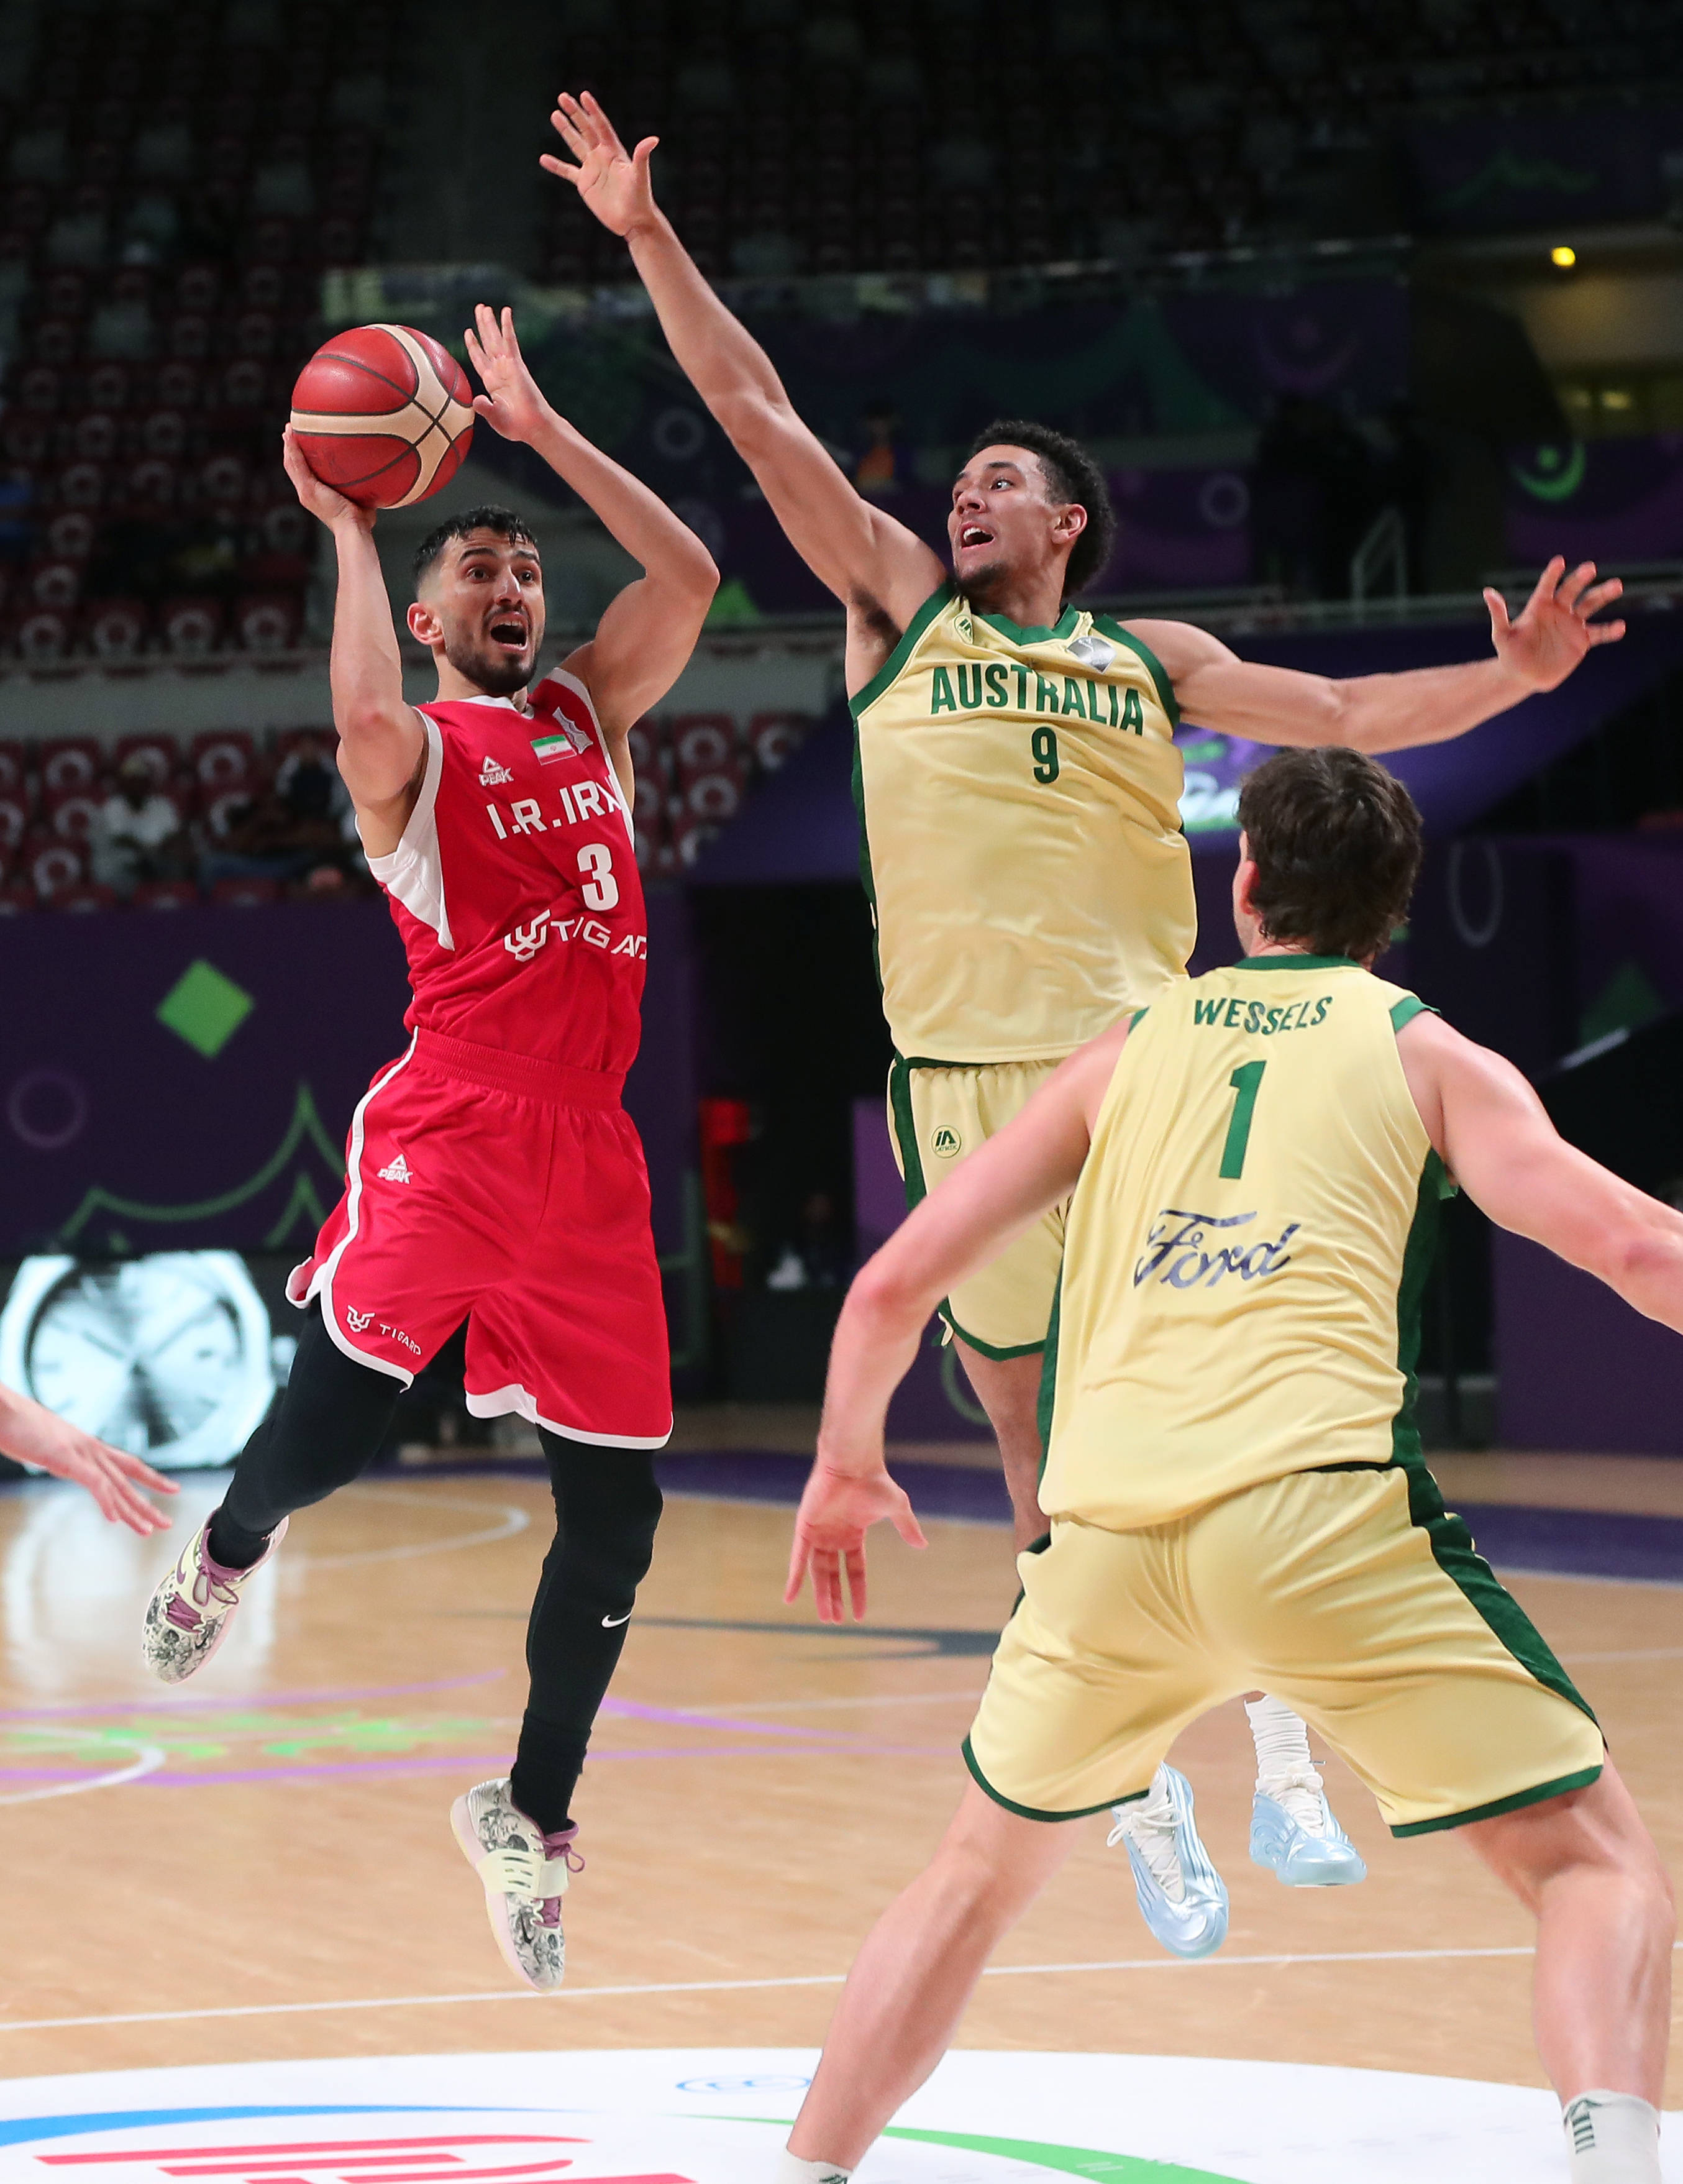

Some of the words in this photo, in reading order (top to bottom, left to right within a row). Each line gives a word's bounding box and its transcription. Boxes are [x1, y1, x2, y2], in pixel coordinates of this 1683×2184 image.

[931, 663, 1144, 736] AUSTRALIA
[478, 767, 514, 787] PEAK
[1031, 726, 1060, 784] 9
[577, 843, 619, 912] 3
[1194, 996, 1333, 1036] WESSELS
[1219, 1059, 1267, 1179] 1
[376, 1167, 414, 1184] PEAK
[1133, 1209, 1302, 1289] Ford
[379, 1323, 422, 1356] TIGARD
